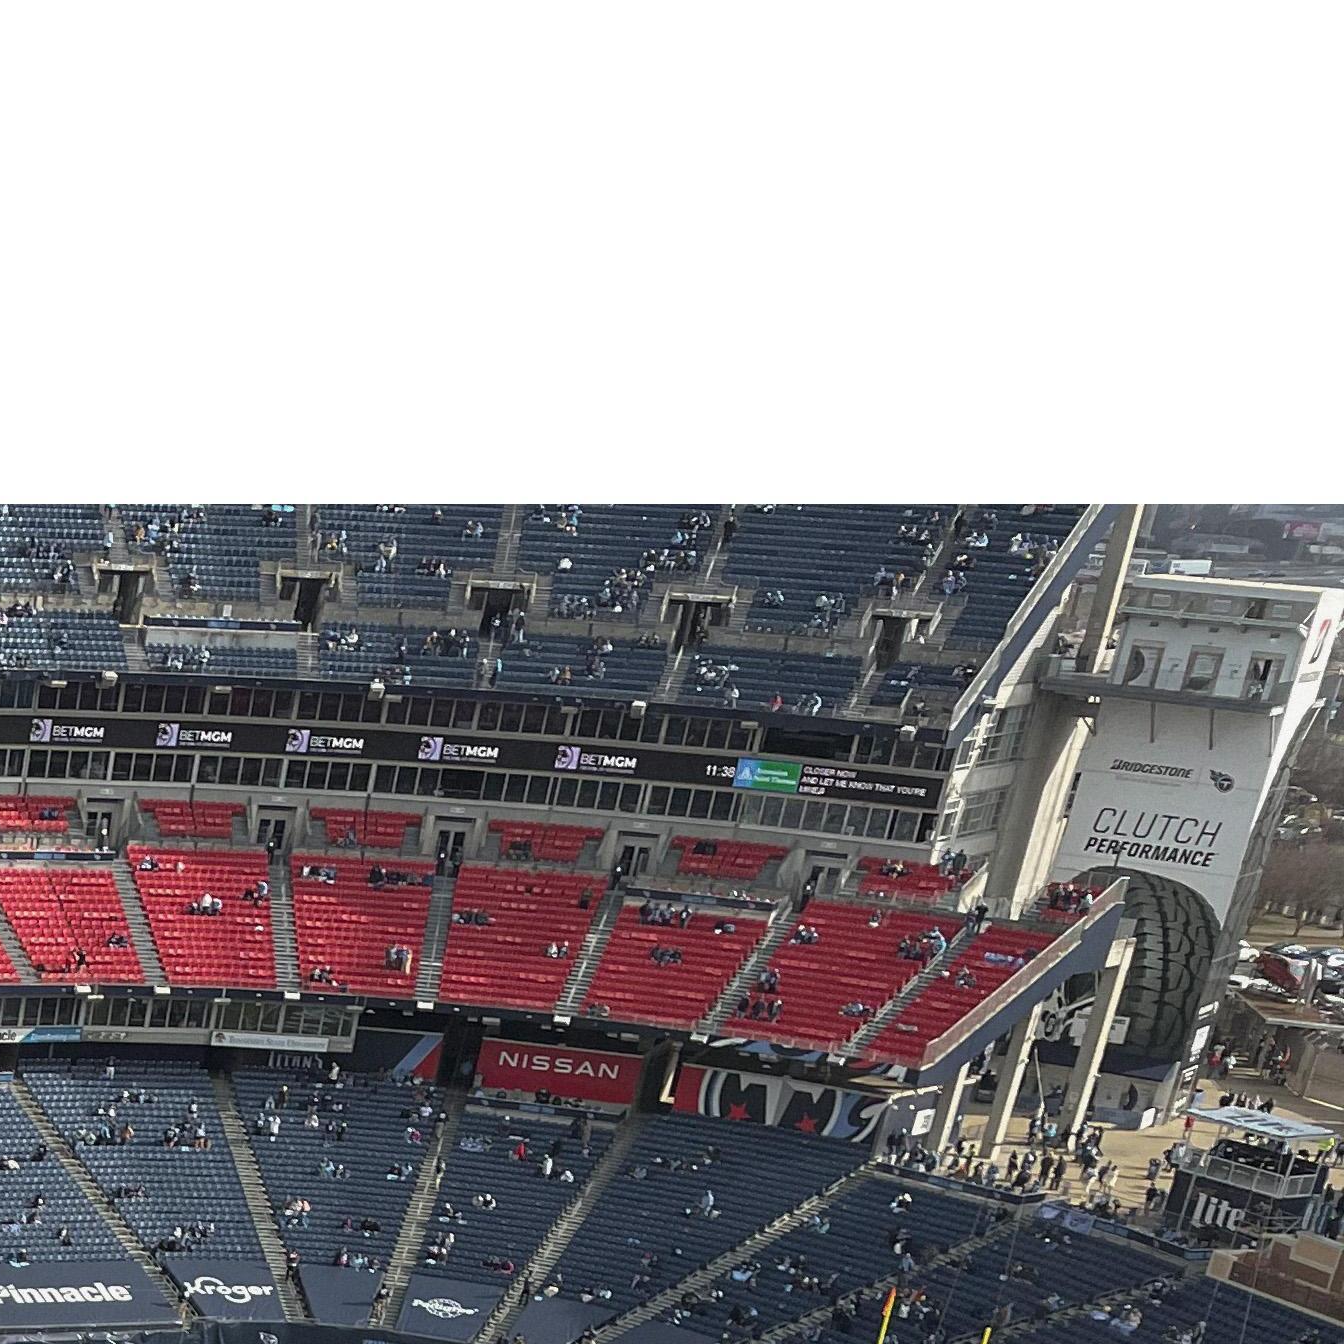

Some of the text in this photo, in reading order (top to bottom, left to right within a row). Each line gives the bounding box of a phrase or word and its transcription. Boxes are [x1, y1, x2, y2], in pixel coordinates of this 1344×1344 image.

[52, 725, 104, 739] BETMGM
[179, 729, 232, 744] BETMGM
[310, 735, 364, 751] BETMGM
[443, 743, 499, 760] BETMGM
[580, 753, 637, 769] BETMGM
[1110, 759, 1194, 779] BRIDGESTONE
[1093, 807, 1223, 847] CLUTCH
[1084, 837, 1216, 867] PERFORMANCE
[499, 1051, 619, 1079] NISSAN
[1191, 1192, 1246, 1231] lite
[183, 1276, 274, 1304] Kroger
